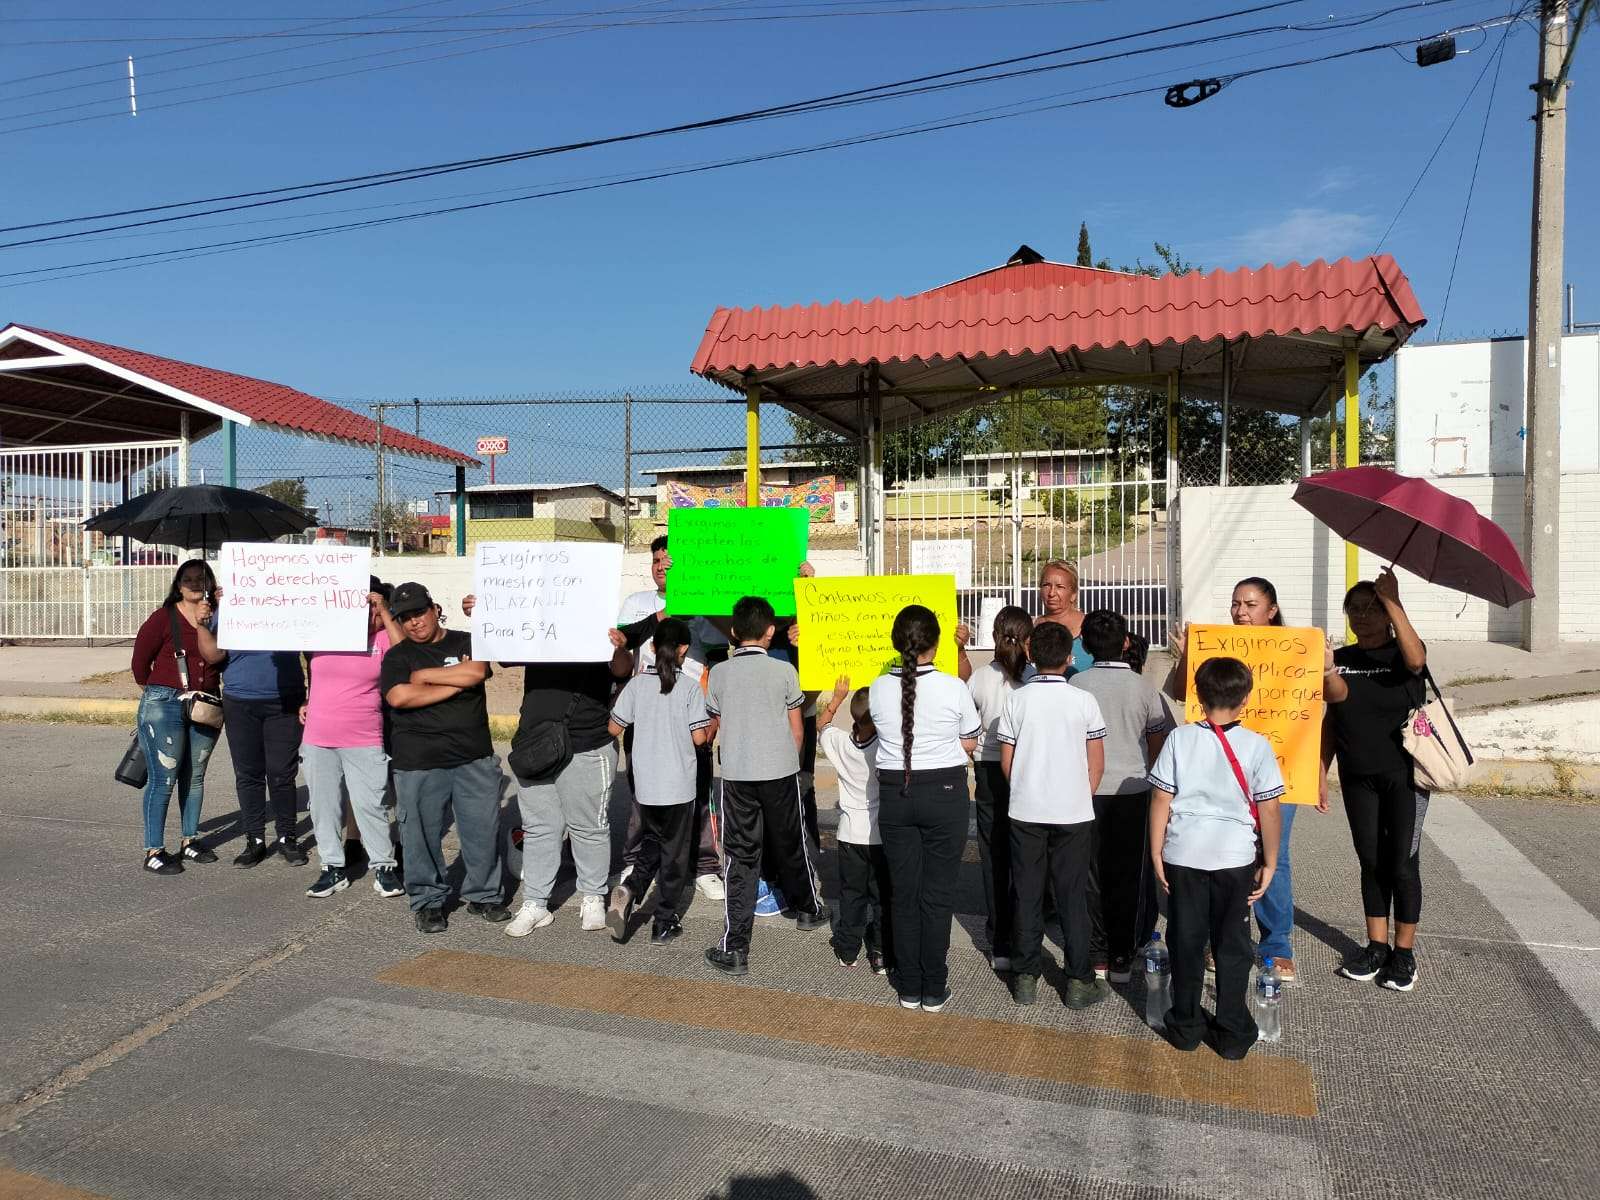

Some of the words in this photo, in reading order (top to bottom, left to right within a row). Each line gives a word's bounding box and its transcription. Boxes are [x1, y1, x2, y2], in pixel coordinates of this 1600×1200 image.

[478, 440, 506, 450] OXXO
[232, 547, 310, 572] Hagamos
[480, 546, 569, 570] Exigimos
[265, 572, 340, 586] derechos
[483, 576, 544, 590] maestro
[230, 593, 246, 606] de
[250, 594, 318, 607] nuestros
[324, 588, 368, 609] HIJOS
[804, 582, 888, 607] Contamos
[857, 611, 878, 623] con
[482, 622, 514, 639] Para
[1194, 630, 1307, 657] Exigimos
[1246, 661, 1319, 681] xplica-
[1258, 687, 1323, 706] porque
[1239, 707, 1310, 721] enemos
